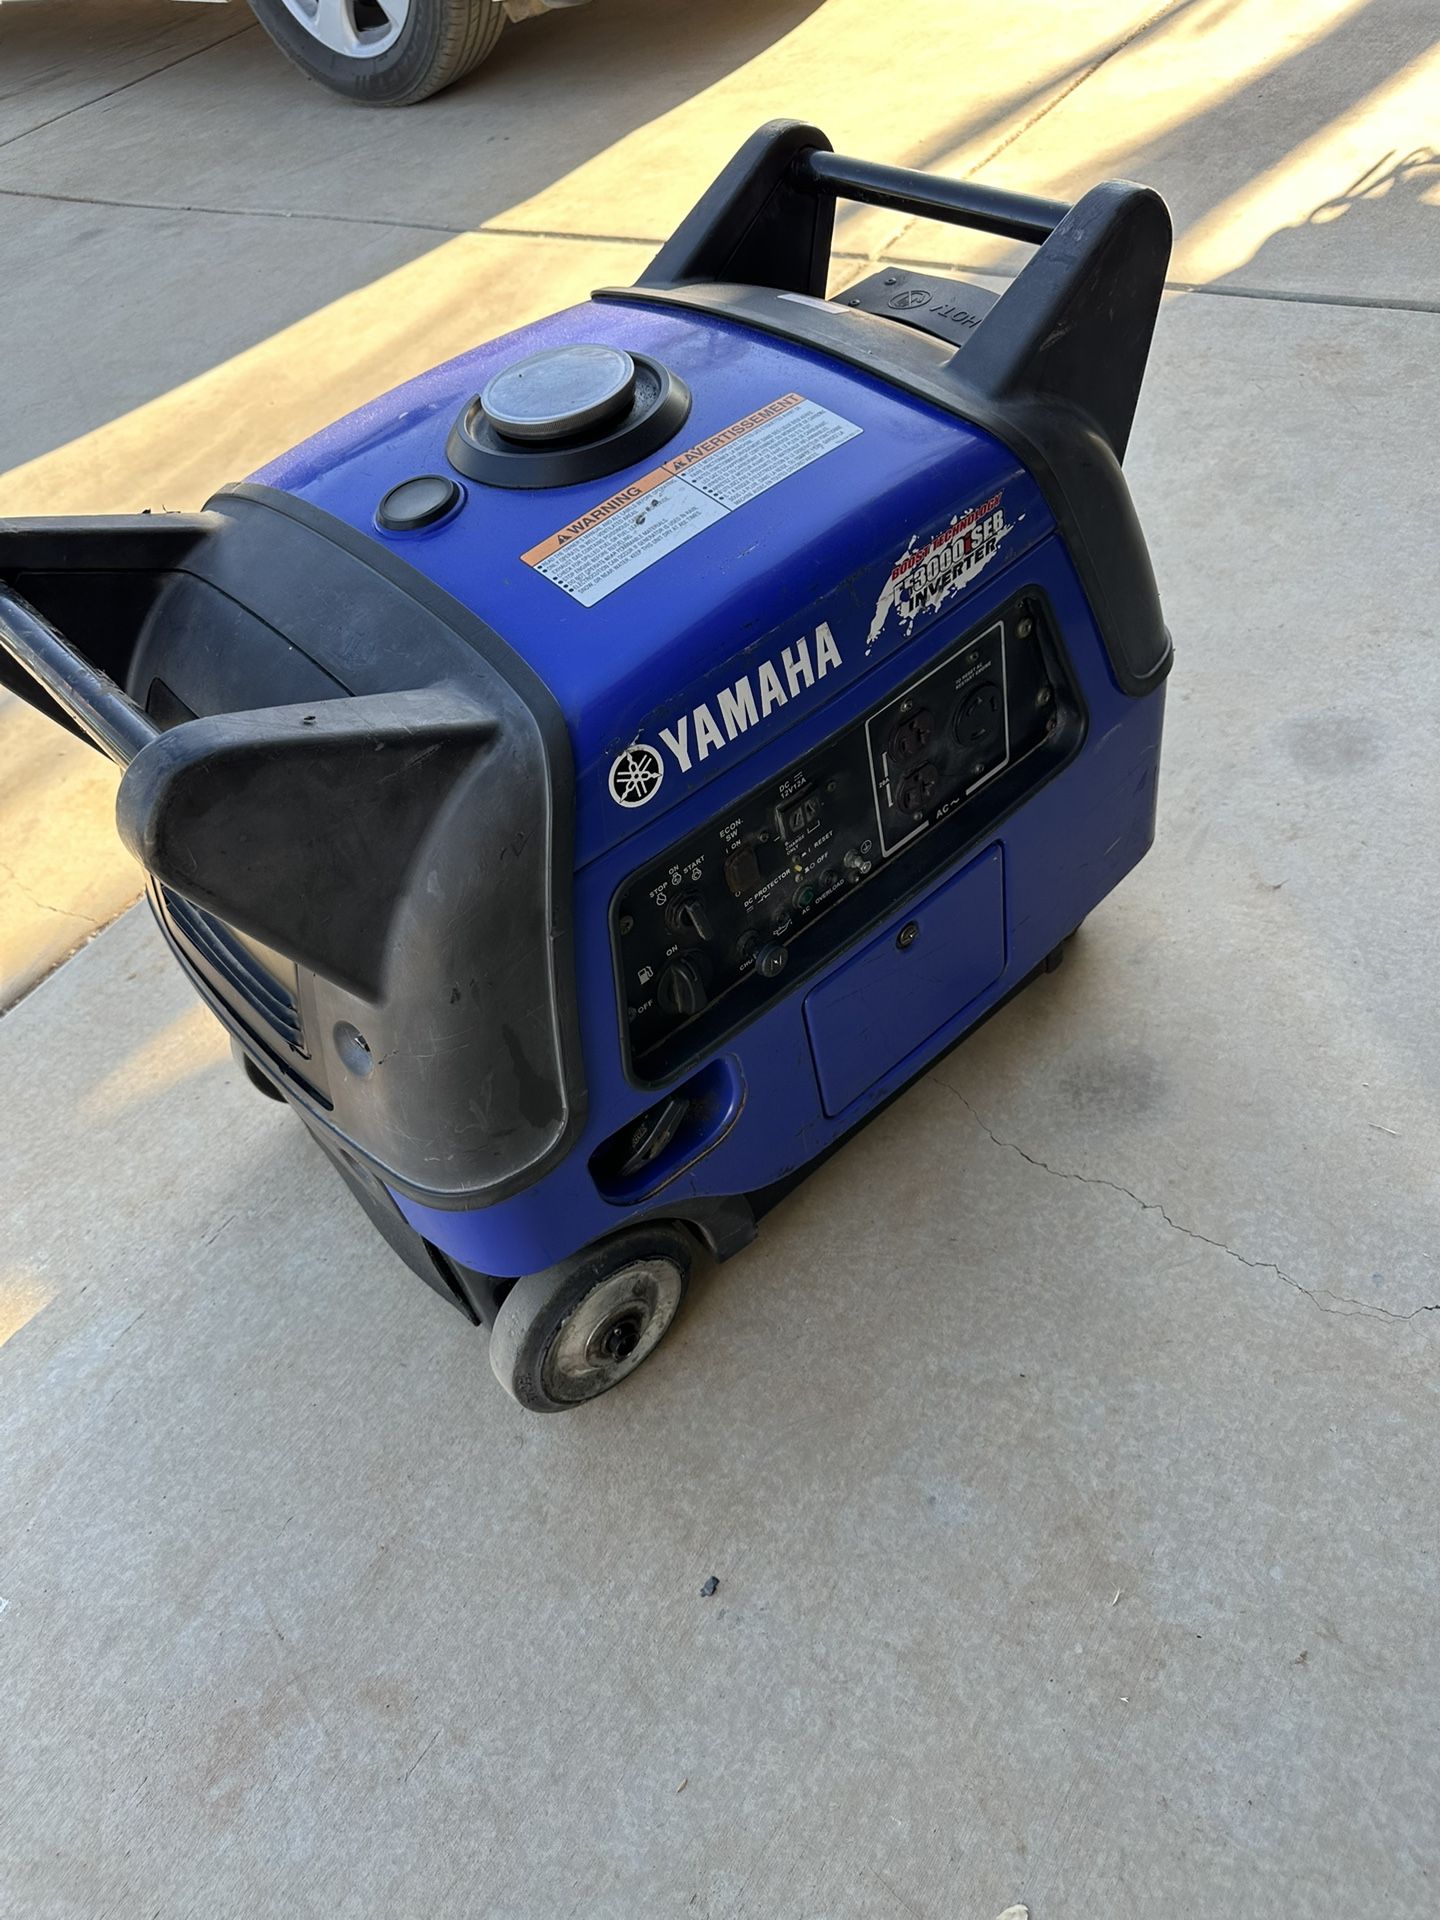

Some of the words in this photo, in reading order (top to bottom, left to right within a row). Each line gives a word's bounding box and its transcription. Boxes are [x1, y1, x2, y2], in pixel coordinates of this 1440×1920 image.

[683, 393, 800, 464] AVERTISSEMENT
[566, 485, 643, 535] WARNING
[891, 544, 930, 580] BOOST
[932, 492, 1003, 551] TECHNOLOGY
[908, 538, 997, 612] INVERTER
[658, 621, 843, 774] YAMAHA
[779, 780, 790, 793] DC
[780, 777, 807, 800] 12V12A
[936, 803, 950, 819] AC
[725, 829, 738, 842] SW
[814, 830, 834, 848] RESET
[731, 839, 741, 850] ON
[683, 854, 705, 874] START
[816, 851, 829, 865] OFF
[668, 864, 679, 875] ON
[649, 881, 668, 898] STOP
[743, 898, 754, 908] DC
[754, 868, 791, 900] PROTECTOR
[815, 879, 845, 904] OVERLOAD
[802, 905, 811, 915] AC
[666, 944, 678, 957] ON
[637, 998, 654, 1014] OFF
